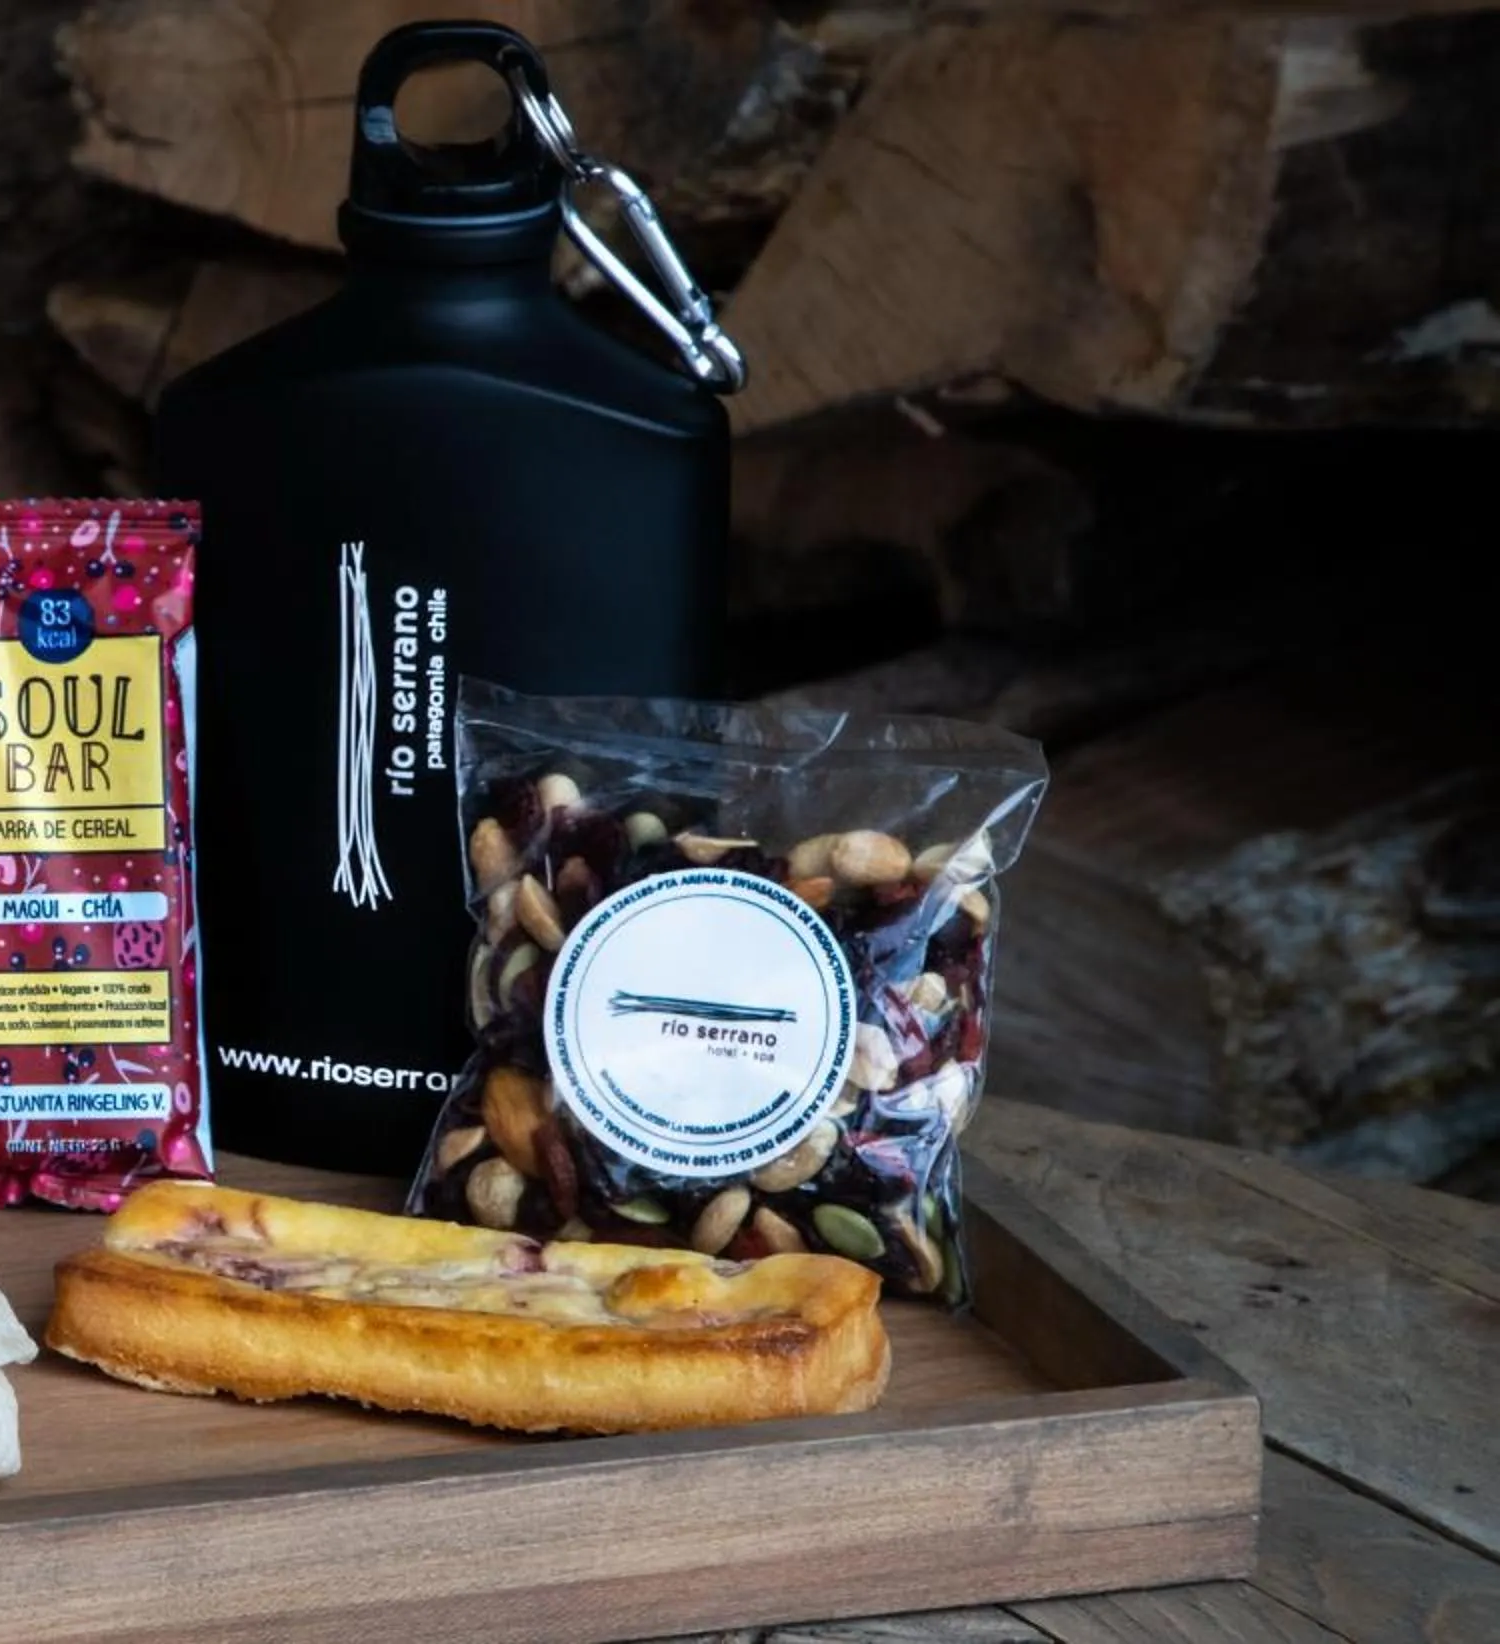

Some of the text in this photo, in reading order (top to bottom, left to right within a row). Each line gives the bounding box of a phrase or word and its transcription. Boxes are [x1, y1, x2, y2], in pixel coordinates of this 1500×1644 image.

[40, 600, 71, 625] 83
[36, 627, 77, 649] kcal
[385, 585, 419, 795] río serrano
[426, 587, 447, 769] patagonia chile
[6, 741, 111, 793] BAR
[43, 819, 66, 839] DE
[71, 817, 137, 838] CEREAL
[3, 899, 59, 919] MAQUI
[82, 893, 123, 918] CHÍA
[796, 908, 813, 925] DE
[808, 921, 846, 985] PRODUCTOS
[661, 1019, 777, 1047] río serrano
[708, 1044, 737, 1057] hotel
[753, 1051, 775, 1063] spa
[0, 1093, 65, 1113] JUANITA
[68, 1092, 149, 1111] RINGELING
[152, 1092, 166, 1111] V.
[650, 1147, 689, 1165] MARIO
